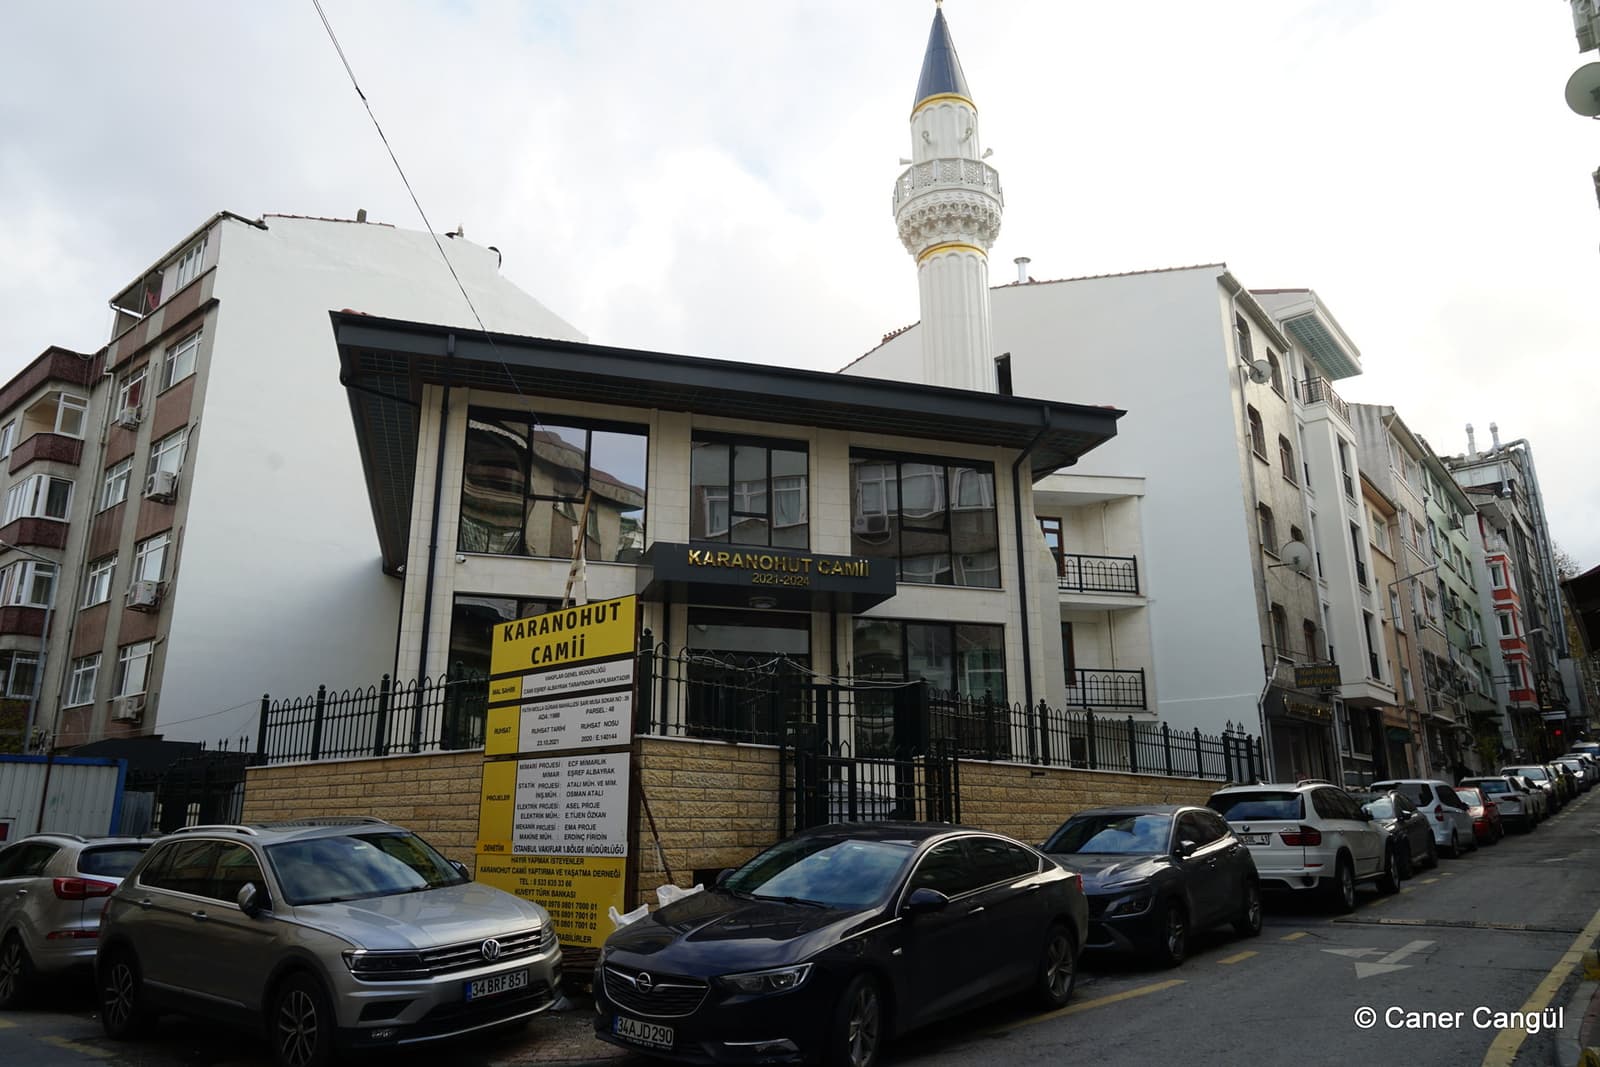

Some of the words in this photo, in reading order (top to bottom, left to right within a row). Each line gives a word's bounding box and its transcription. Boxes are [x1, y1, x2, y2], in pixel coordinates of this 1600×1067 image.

[688, 549, 813, 573] KARANOHUT
[752, 572, 809, 586] 2021-2024
[503, 602, 621, 642] KARANOHUT
[581, 722, 601, 730] RUHSAT
[604, 720, 619, 728] NOSU
[531, 727, 550, 735] RUHSAT
[585, 768, 615, 776] ALBAYRAK
[566, 790, 586, 798] OSMAN
[581, 801, 600, 809] PROJE
[578, 823, 596, 831] PROJE
[586, 844, 625, 854] MÜDÜRLÜĞÜ
[480, 866, 511, 874] KARANOHUT
[528, 868, 555, 876] YAPTIRMA
[564, 868, 591, 878] YAŞATMA
[592, 868, 621, 878] DERNEĞİ
[536, 888, 551, 898] TÜRK
[551, 890, 576, 899] BANKASI
[472, 981, 485, 996] 34
[487, 976, 506, 993] BRF
[508, 972, 527, 988] 851
